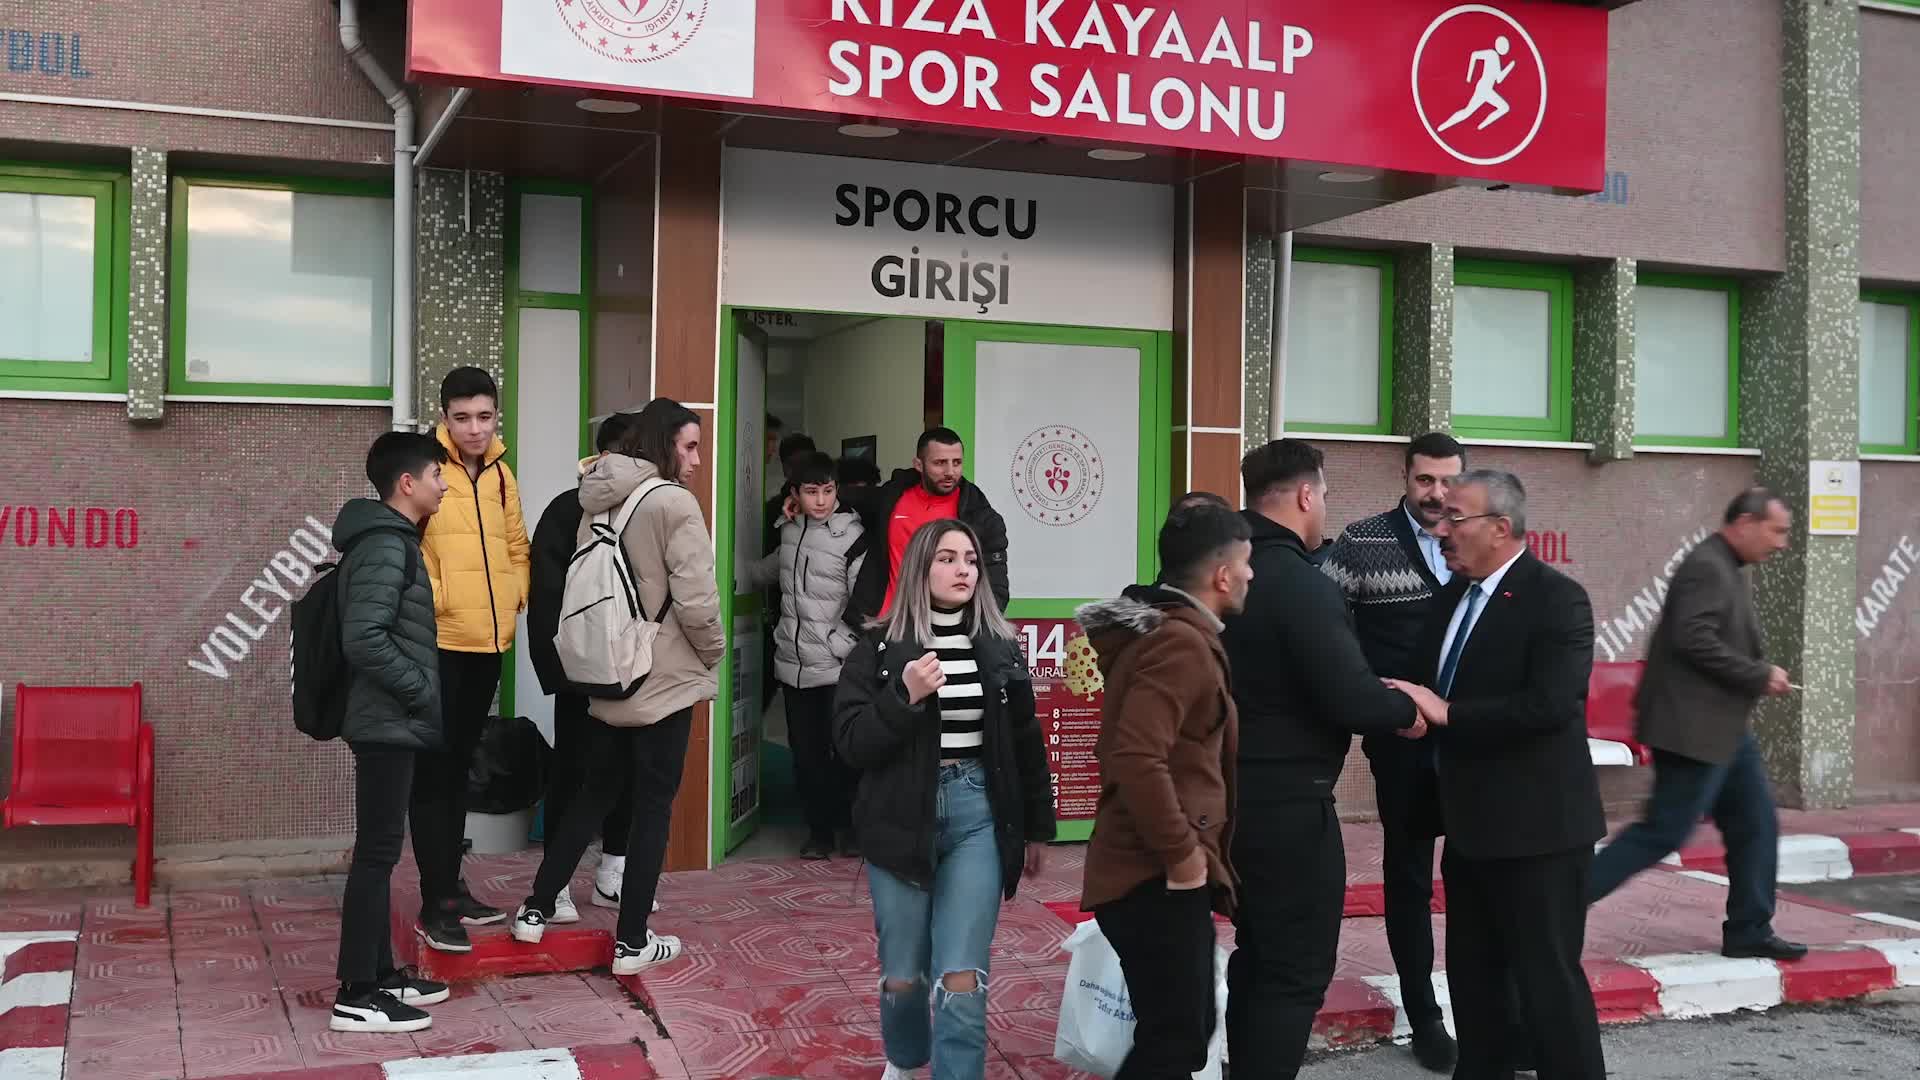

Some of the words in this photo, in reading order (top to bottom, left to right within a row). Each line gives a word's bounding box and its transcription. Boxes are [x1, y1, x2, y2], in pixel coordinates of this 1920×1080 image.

[0, 29, 92, 80] BOL
[1024, 0, 1314, 75] KAYAALP
[828, 39, 1003, 112] SPOR
[1029, 62, 1285, 141] SALONU
[835, 183, 1037, 240] SPORCU
[871, 245, 1010, 314] GİRİŞİ
[1855, 534, 1920, 638] KARATE
[1020, 623, 1068, 668] 14
[1028, 666, 1068, 679] KURAL
[1052, 708, 1060, 719] 8
[1052, 721, 1060, 732] 9
[1048, 734, 1060, 745] 10
[1050, 751, 1060, 762] 11
